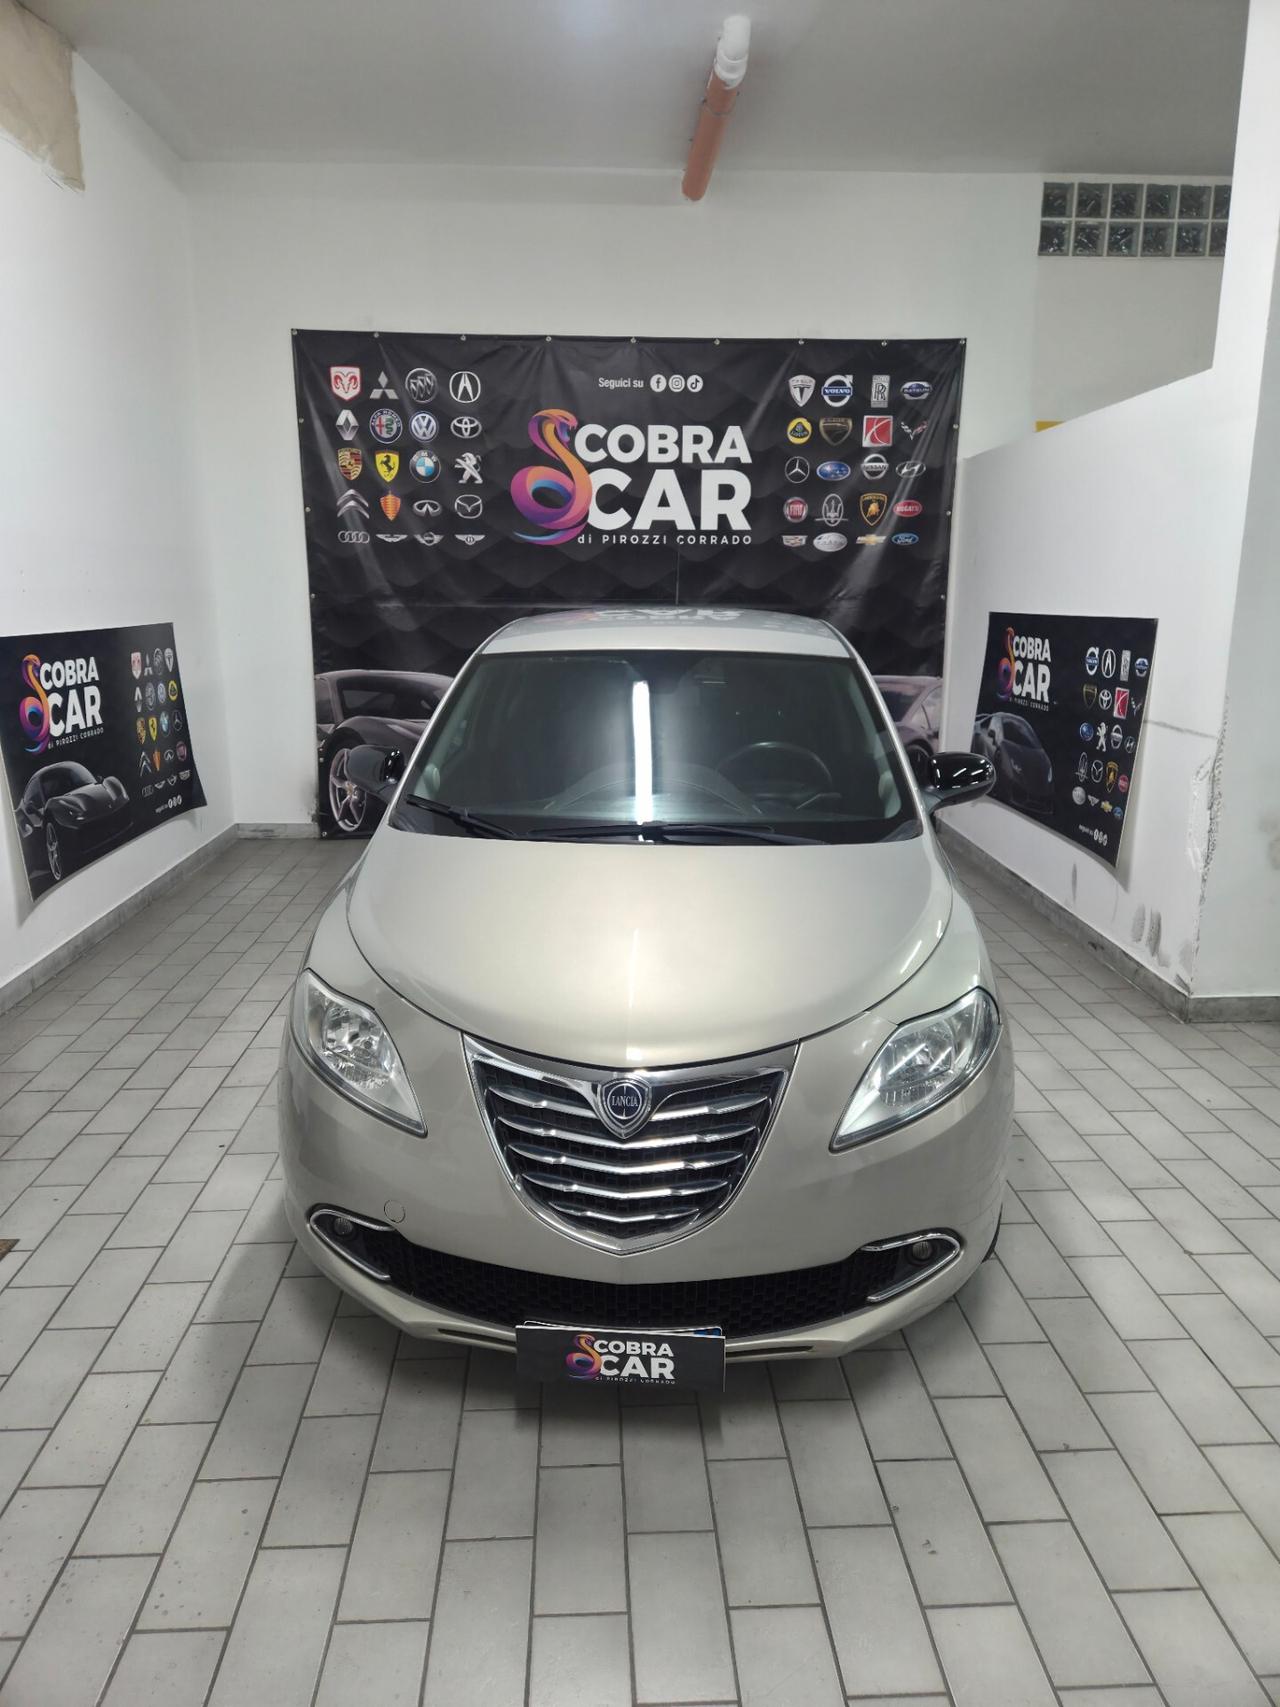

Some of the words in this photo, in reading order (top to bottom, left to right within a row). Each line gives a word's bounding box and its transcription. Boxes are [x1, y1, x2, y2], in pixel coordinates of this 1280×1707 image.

[598, 378, 630, 390] Seguici
[632, 379, 644, 388] su
[574, 424, 752, 464] COBRA
[587, 468, 752, 530] CAR
[577, 534, 592, 544] di
[602, 535, 668, 544] PIROZZI
[677, 535, 752, 544] CORRADO
[1012, 636, 1052, 662] COBRA
[40, 656, 100, 690] COBRA
[1012, 662, 1051, 704] CAR
[48, 686, 104, 737] CAR
[56, 735, 78, 748] PIROZZI
[611, 1096, 638, 1107] LANCIA
[593, 1339, 674, 1357] COBRA
[600, 1354, 676, 1380] CAR
